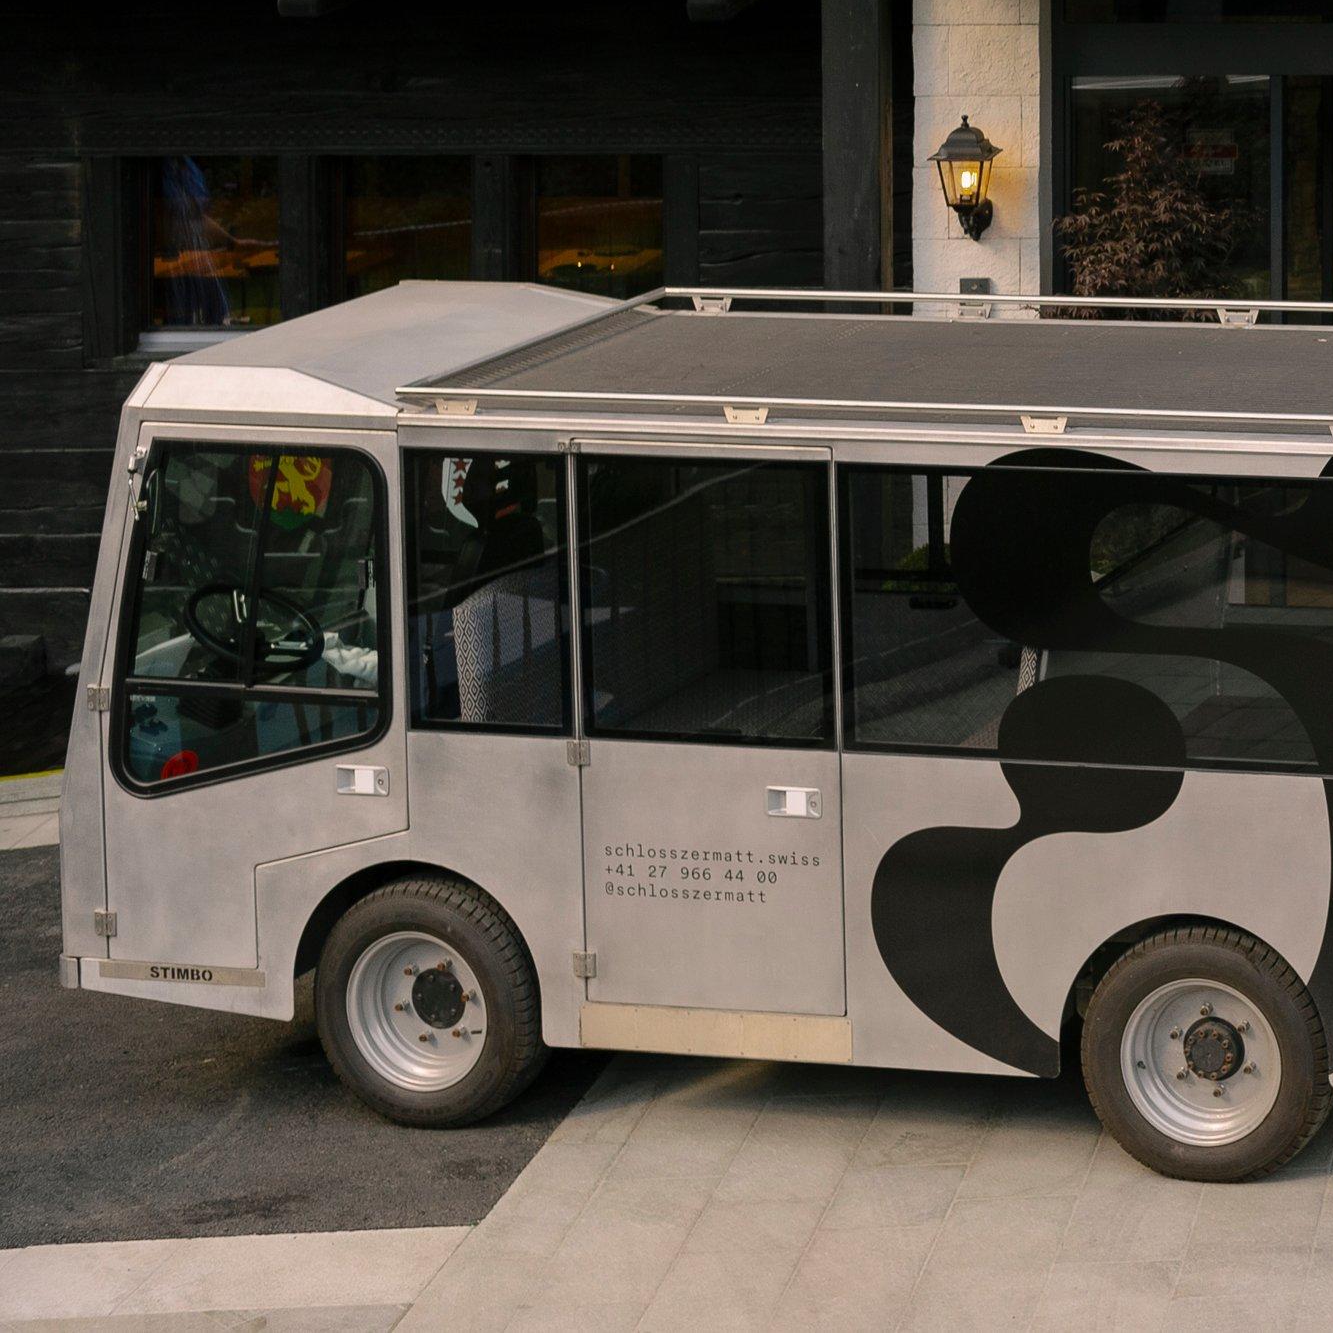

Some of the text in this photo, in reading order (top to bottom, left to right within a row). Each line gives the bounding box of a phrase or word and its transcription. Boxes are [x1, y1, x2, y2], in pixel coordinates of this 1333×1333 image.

[604, 844, 820, 867] schlosszermatt.swiss
[605, 863, 777, 884] +41 27 966 44 00
[605, 881, 767, 903] @schlosszermatt
[150, 966, 213, 981] STIMBO
